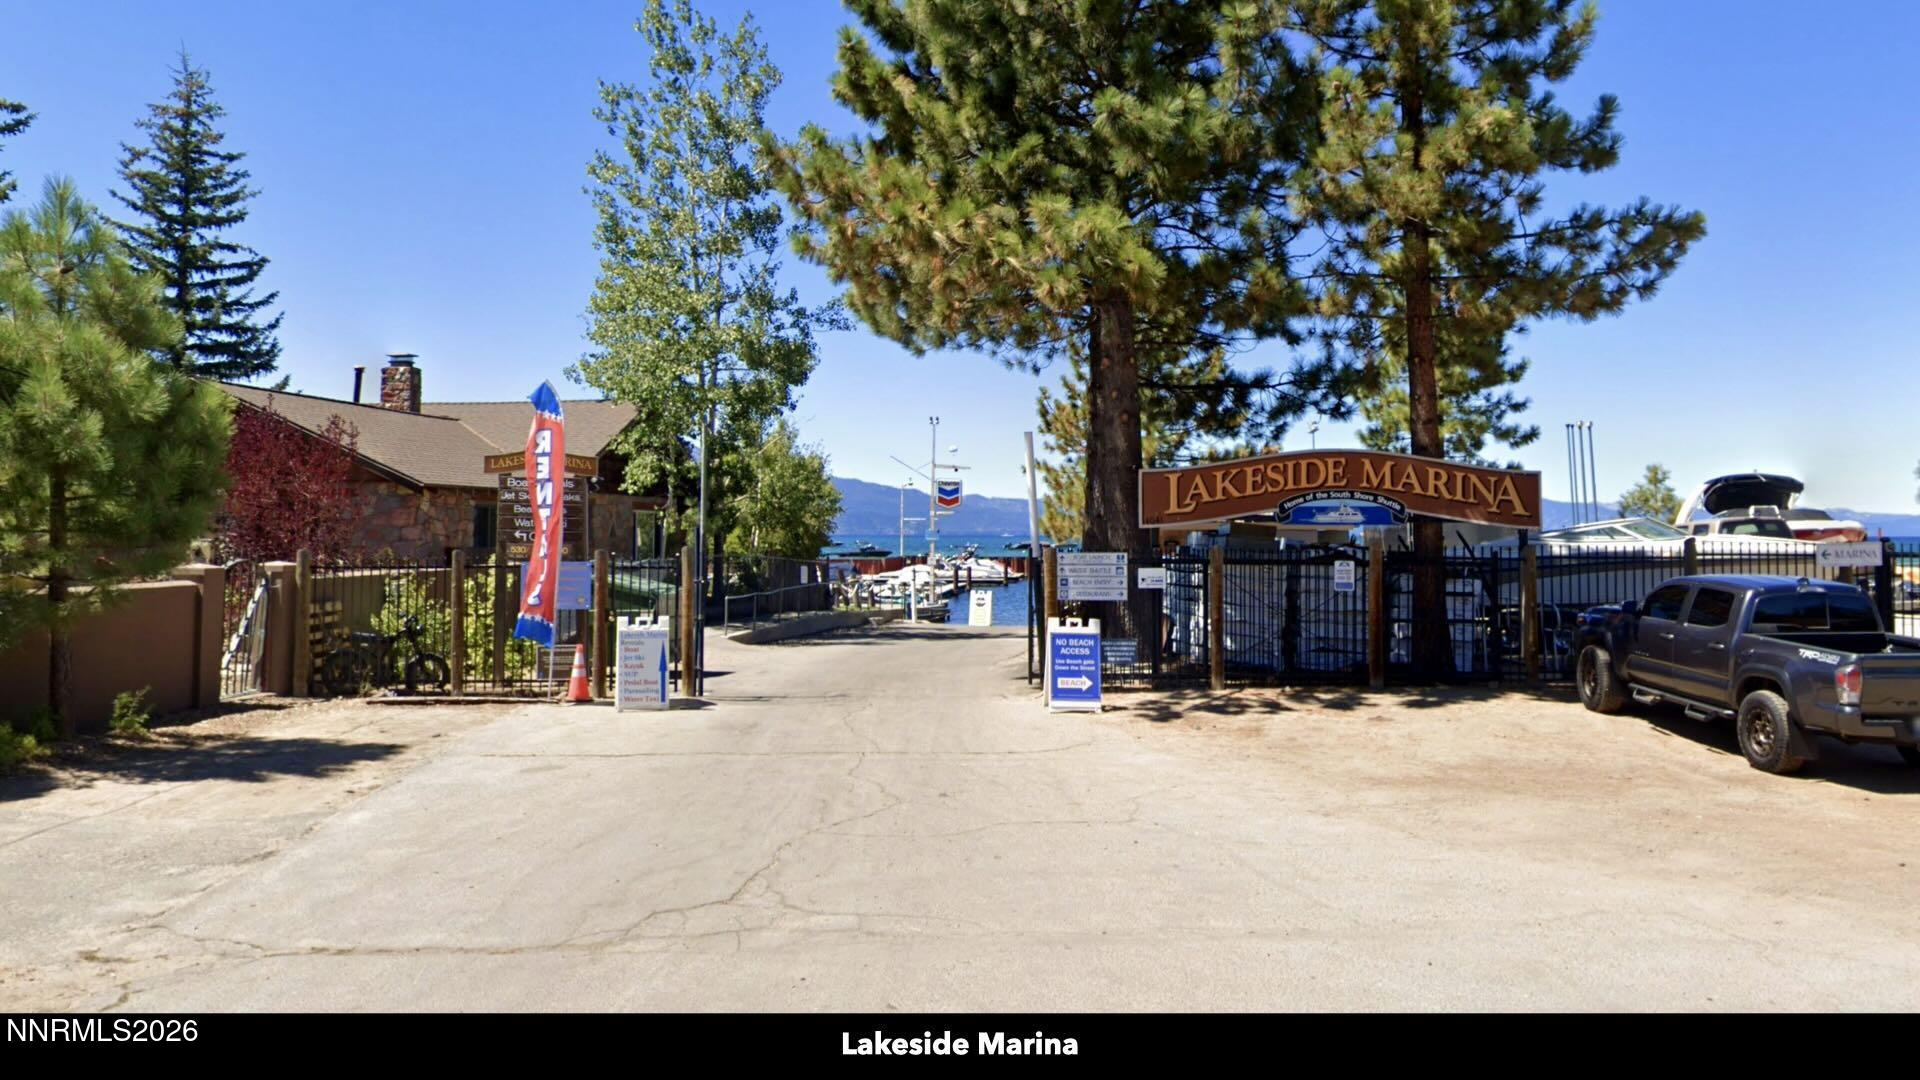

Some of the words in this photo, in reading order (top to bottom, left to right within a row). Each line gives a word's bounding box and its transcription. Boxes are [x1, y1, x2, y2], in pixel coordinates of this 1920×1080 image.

[491, 457, 526, 469] LAKES
[565, 458, 592, 470] RINA
[507, 478, 528, 487] Boa
[1164, 457, 1348, 515] LAKESIDE
[1360, 458, 1532, 516] MARINA
[501, 491, 515, 500] Jet
[1284, 498, 1304, 509] Home
[1354, 492, 1374, 501] Shore
[1377, 497, 1402, 510] Shuttle
[1834, 549, 1878, 561] MARINA
[1055, 638, 1067, 646] NO
[1068, 639, 1095, 647] BEACH
[1060, 647, 1090, 655] ACCESS
[1060, 679, 1087, 687] BEACH
